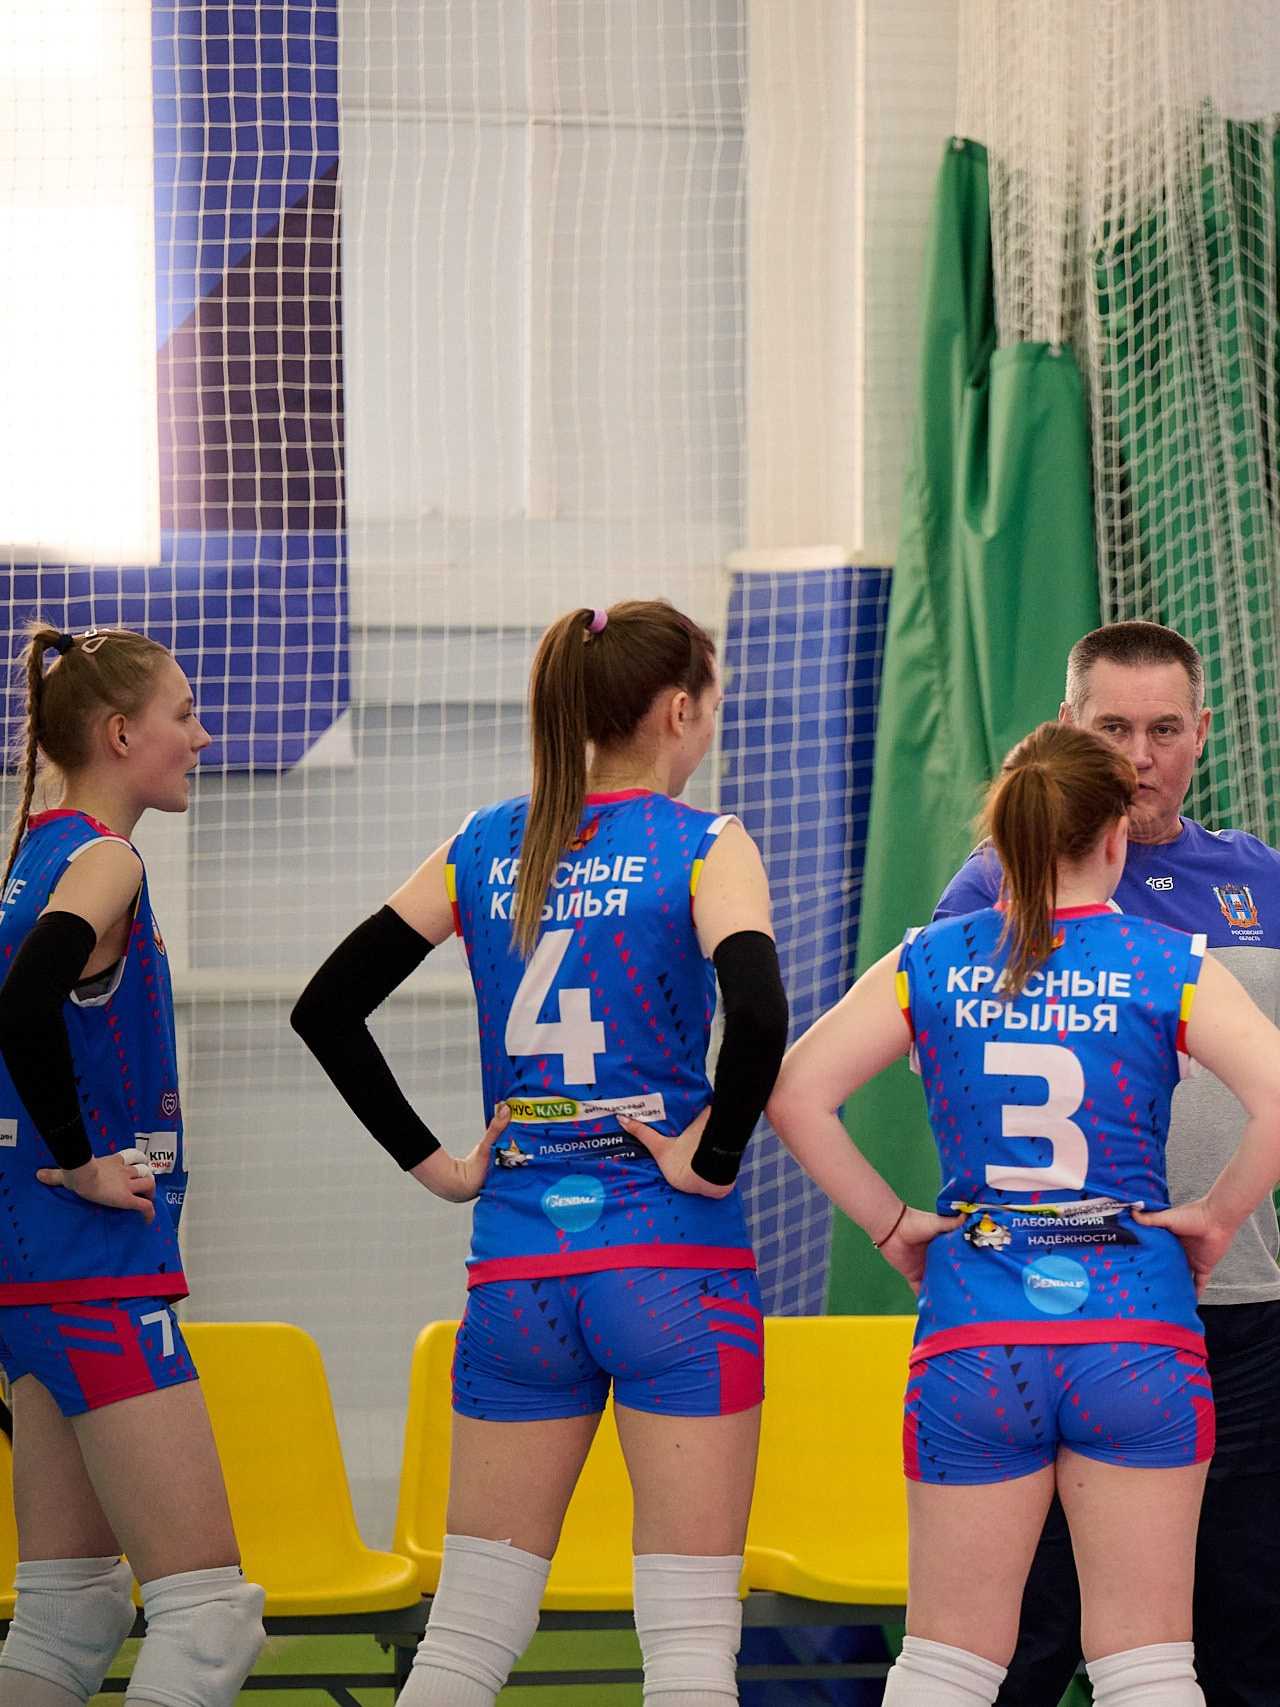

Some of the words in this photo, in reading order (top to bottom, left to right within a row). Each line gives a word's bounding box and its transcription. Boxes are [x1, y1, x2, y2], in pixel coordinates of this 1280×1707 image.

[504, 928, 607, 1085] 4
[955, 999, 1118, 1032] КРЫЛЬЯ
[536, 1103, 573, 1117] КЛУБ
[983, 1041, 1089, 1191] 3
[149, 1151, 174, 1161] КПИ
[539, 1135, 624, 1156] ЛАБОРАТОРИЯ
[1011, 1216, 1105, 1228] ЛАБОРАТОРИЯ
[140, 1309, 175, 1357] 7
